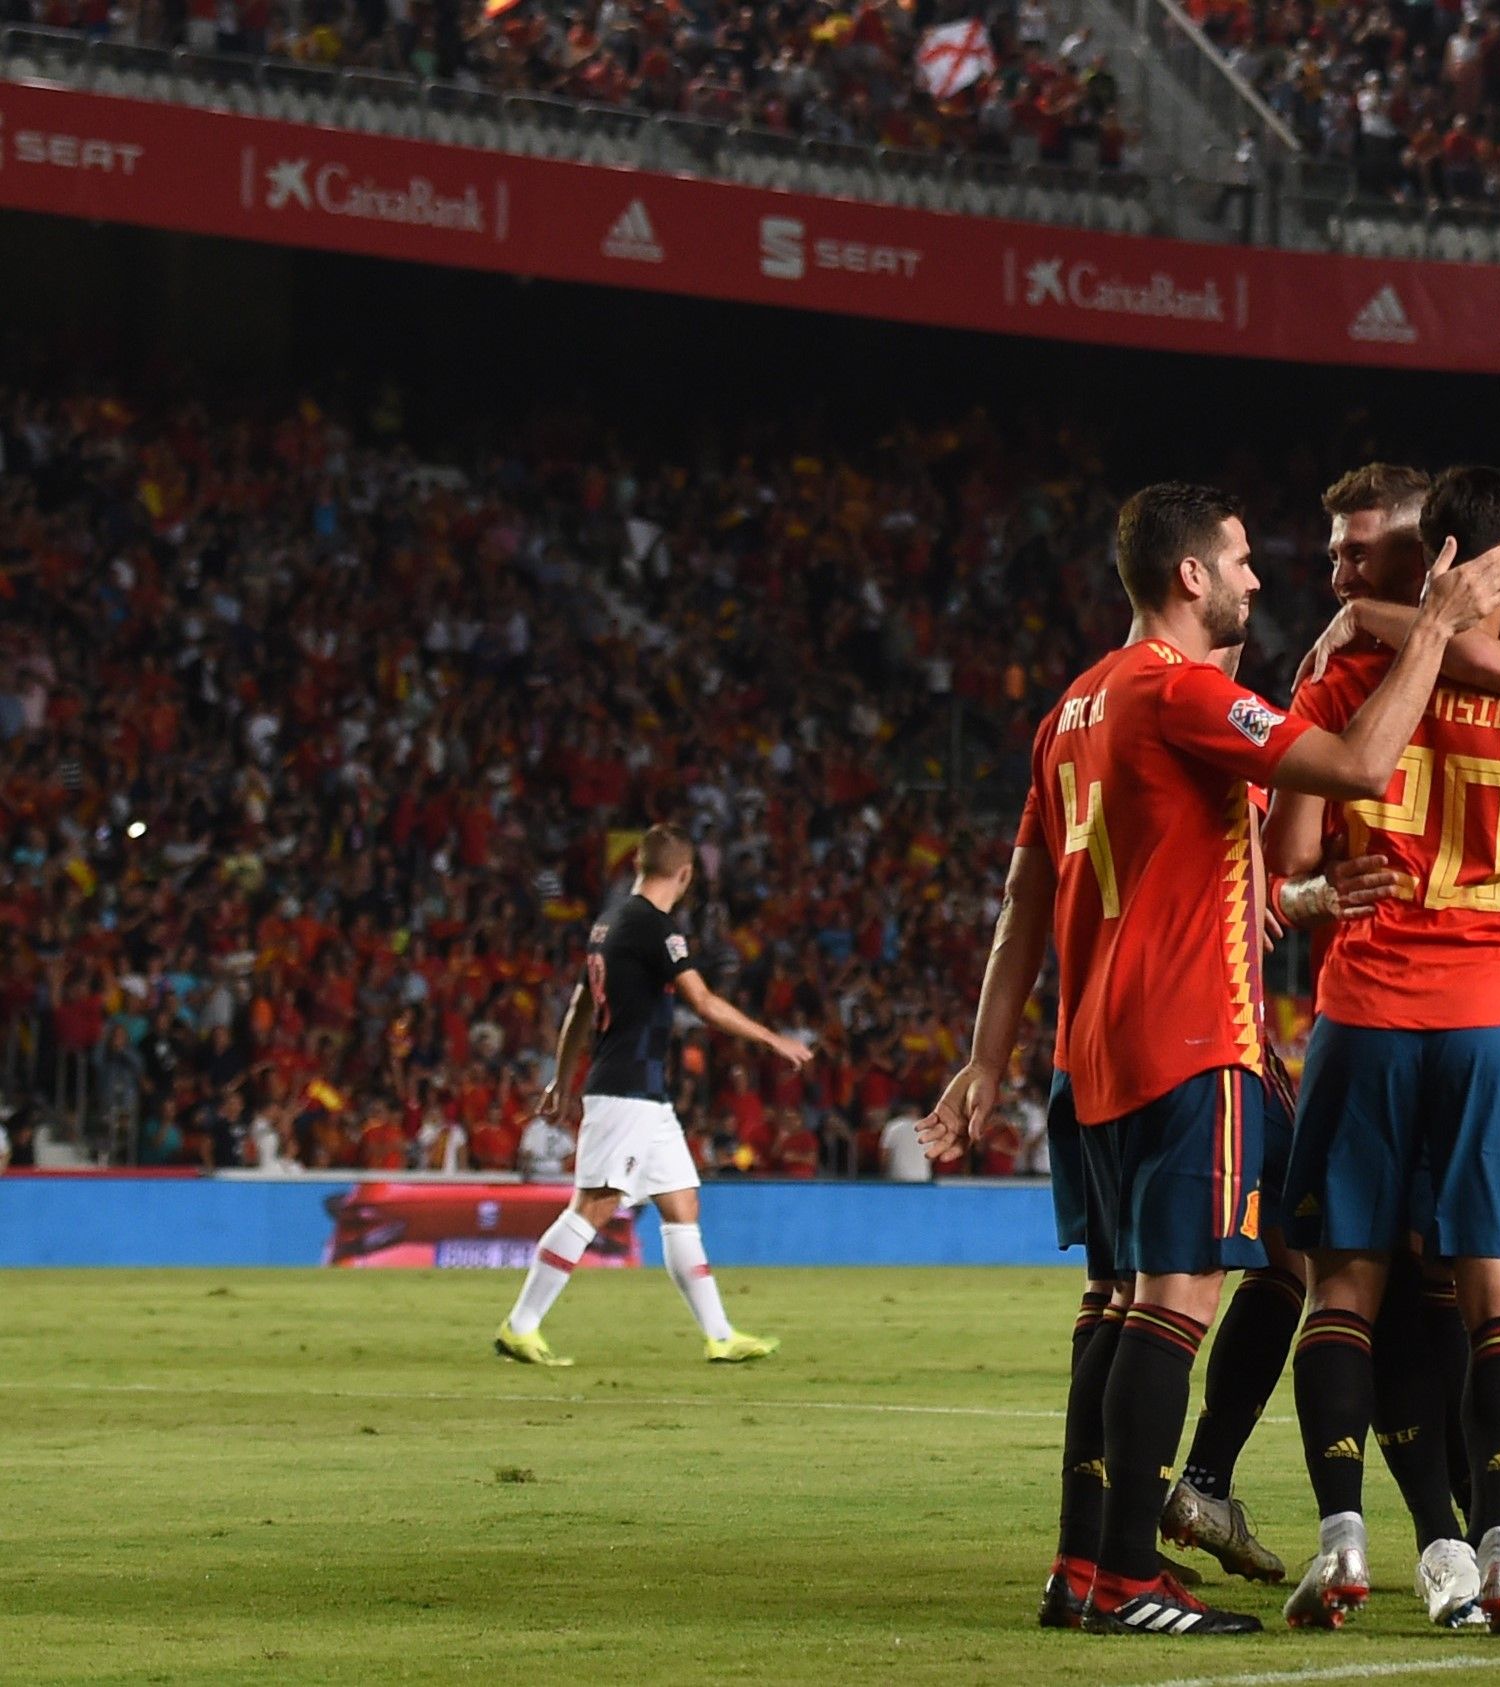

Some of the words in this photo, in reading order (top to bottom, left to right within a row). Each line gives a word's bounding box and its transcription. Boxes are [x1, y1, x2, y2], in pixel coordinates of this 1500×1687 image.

[14, 129, 145, 176] SEAT
[814, 239, 923, 278] SEAT
[1058, 761, 1122, 919] 4
